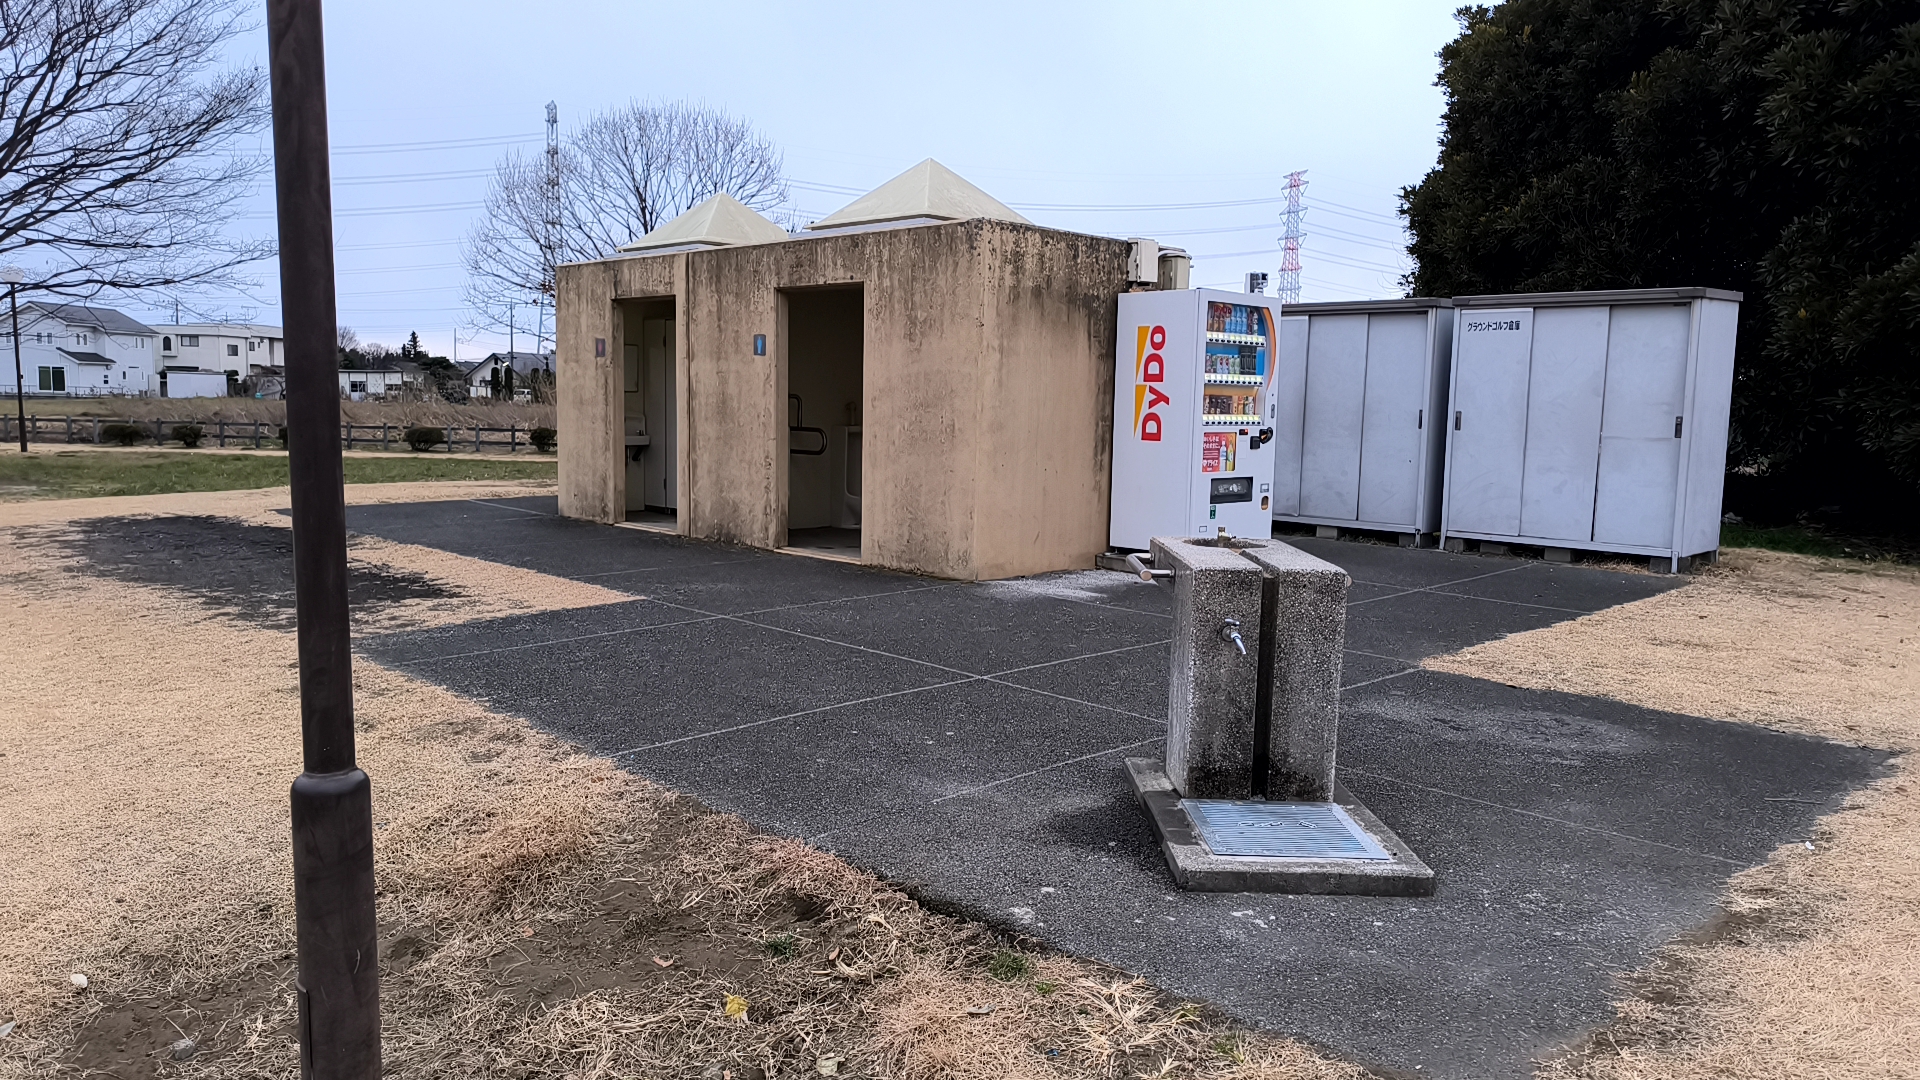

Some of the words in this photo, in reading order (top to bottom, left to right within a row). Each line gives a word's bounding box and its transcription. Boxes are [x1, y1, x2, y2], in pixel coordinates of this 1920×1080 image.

[1467, 320, 1521, 332] グラウンドゴルフ倉庫
[1141, 325, 1170, 441] DyDo
